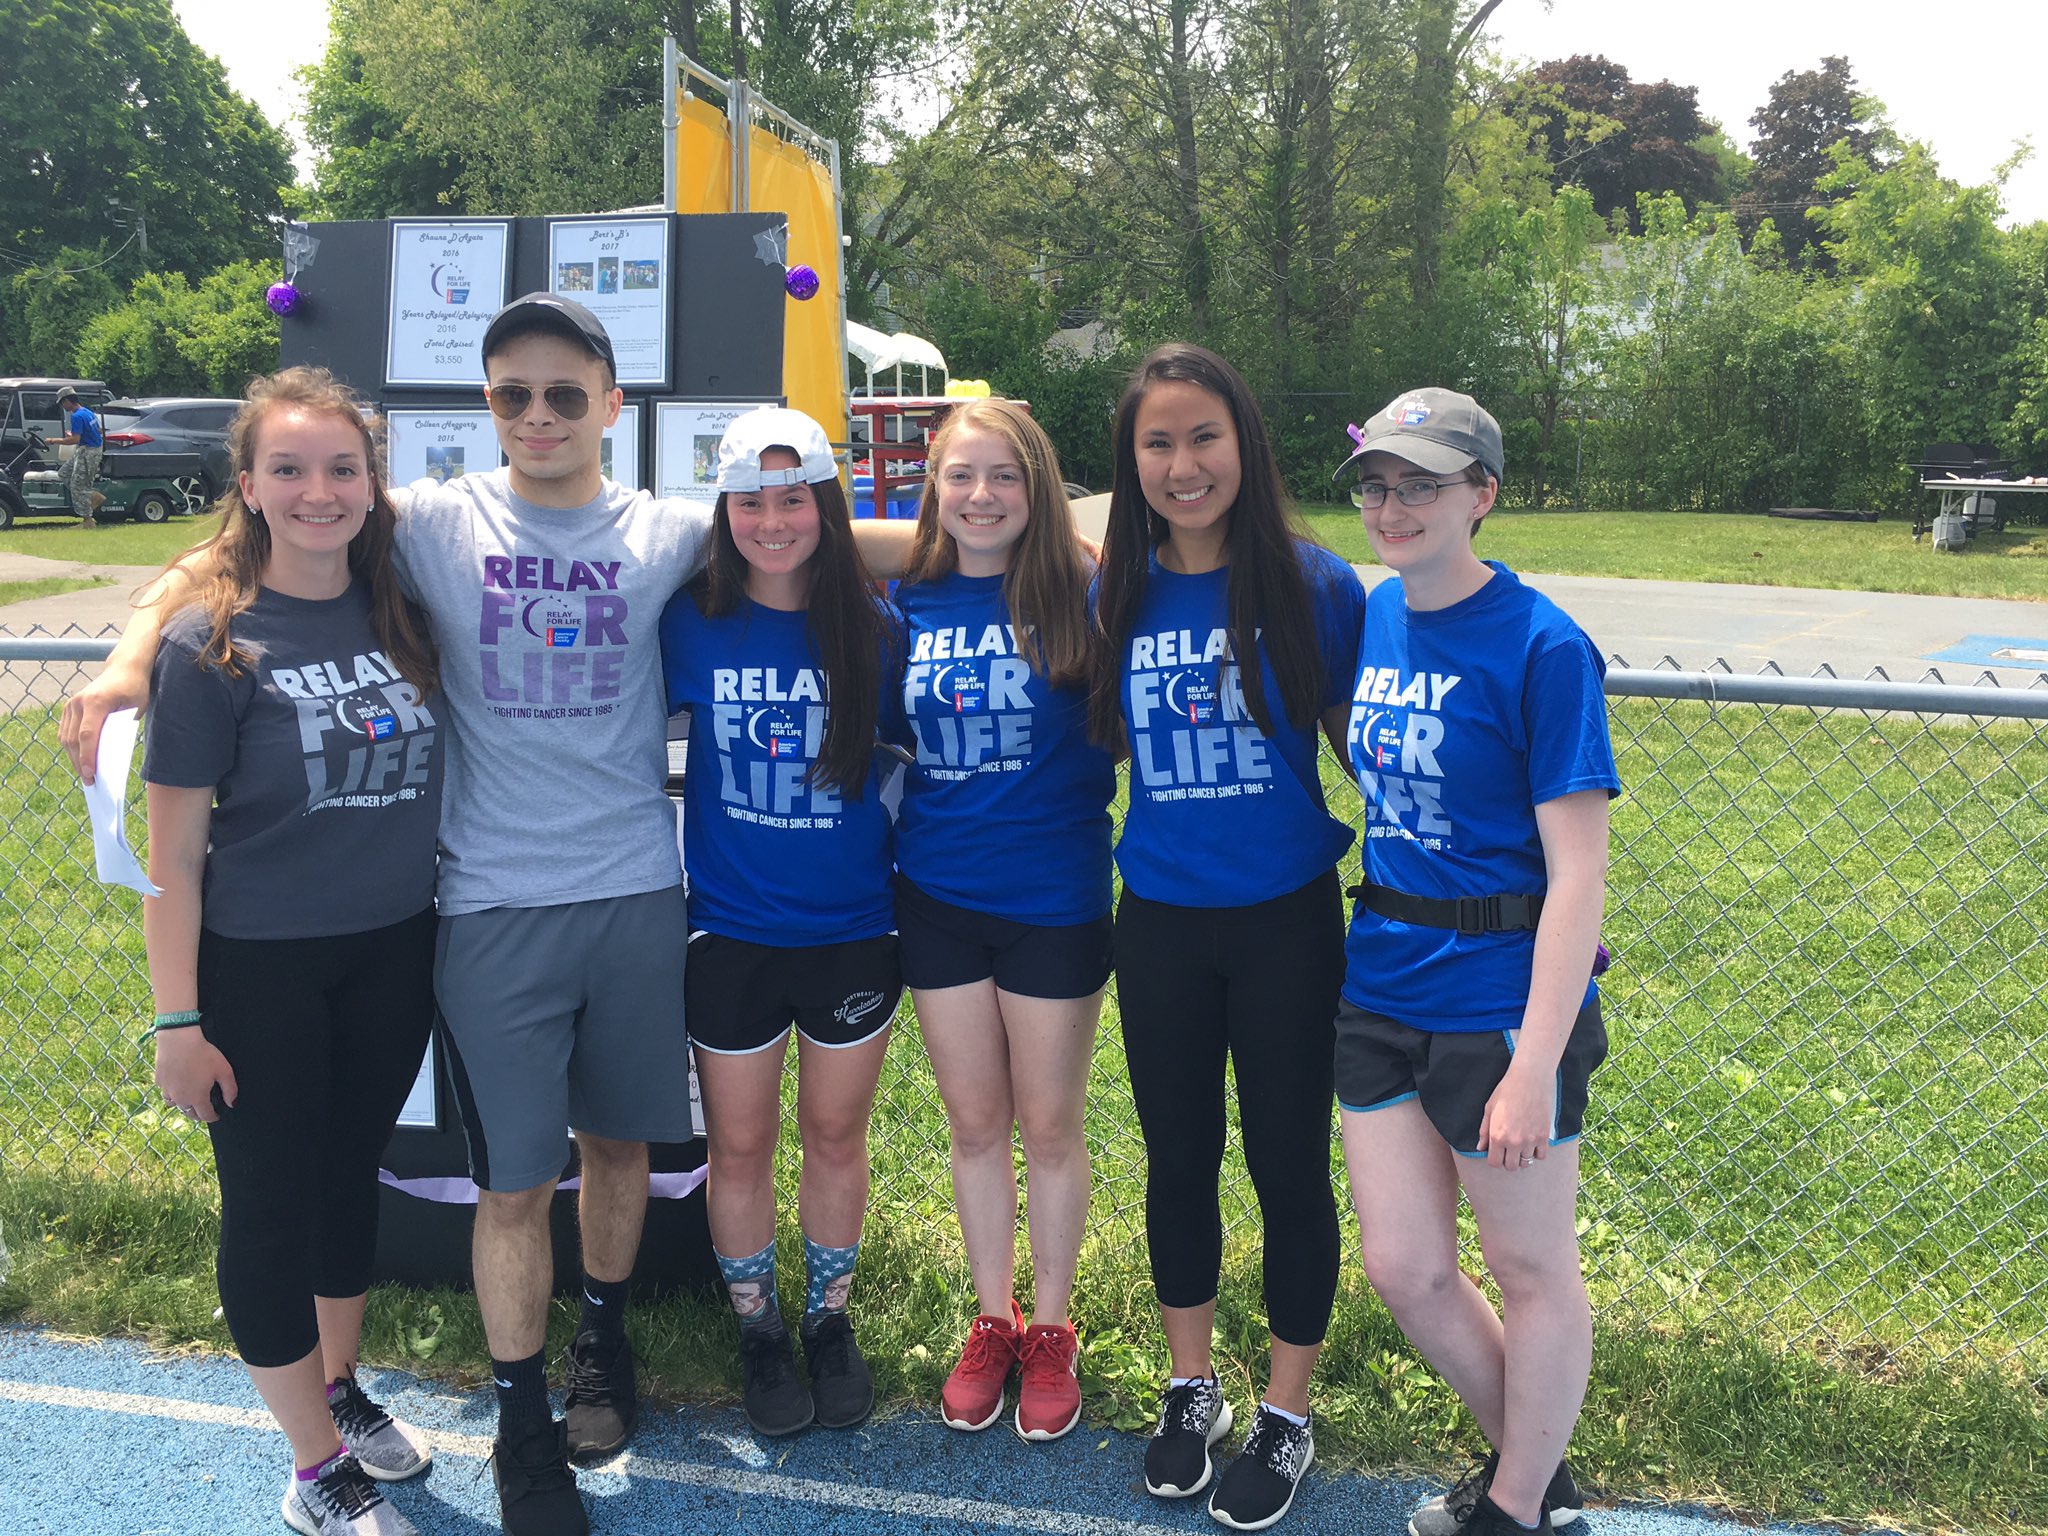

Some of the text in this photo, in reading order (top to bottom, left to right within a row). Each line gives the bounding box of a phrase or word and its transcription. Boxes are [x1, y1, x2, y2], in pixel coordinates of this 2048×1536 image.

[442, 249, 460, 257] 2016
[437, 325, 457, 333] 2016
[424, 339, 446, 349] Total
[434, 355, 463, 365] $3,550
[414, 420, 440, 429] Colleen
[483, 555, 622, 592] RELAY
[909, 624, 1035, 662] RELAY
[1131, 627, 1262, 671] RELA
[271, 651, 402, 699] RELAY
[480, 650, 625, 704] LIFE
[955, 676, 978, 684] RELAY
[970, 682, 985, 690] LIFE
[1186, 685, 1209, 693] RELAY
[1353, 666, 1462, 711] RELAY
[356, 705, 379, 714] RELAY
[360, 707, 391, 720] FOR LIFE
[494, 704, 613, 719] FIGHTING CANCER SINCE 1985
[787, 729, 802, 737] LIFE
[1379, 727, 1398, 737] RELAY
[909, 714, 1032, 767] LIFE
[1377, 735, 1401, 746] FOR LIFE
[1136, 727, 1273, 787] LIFE
[304, 732, 436, 808] LIFE
[978, 761, 1001, 773] SINCE
[1002, 760, 1022, 771] 1985
[718, 753, 842, 814] LIFE
[1151, 783, 1264, 802] FIGHTING CANCER SINCE 1985
[345, 795, 380, 807] CANCER
[727, 806, 833, 829] FIGHTING CANCER SINCE 1985
[843, 991, 875, 1005] NORTHEAST
